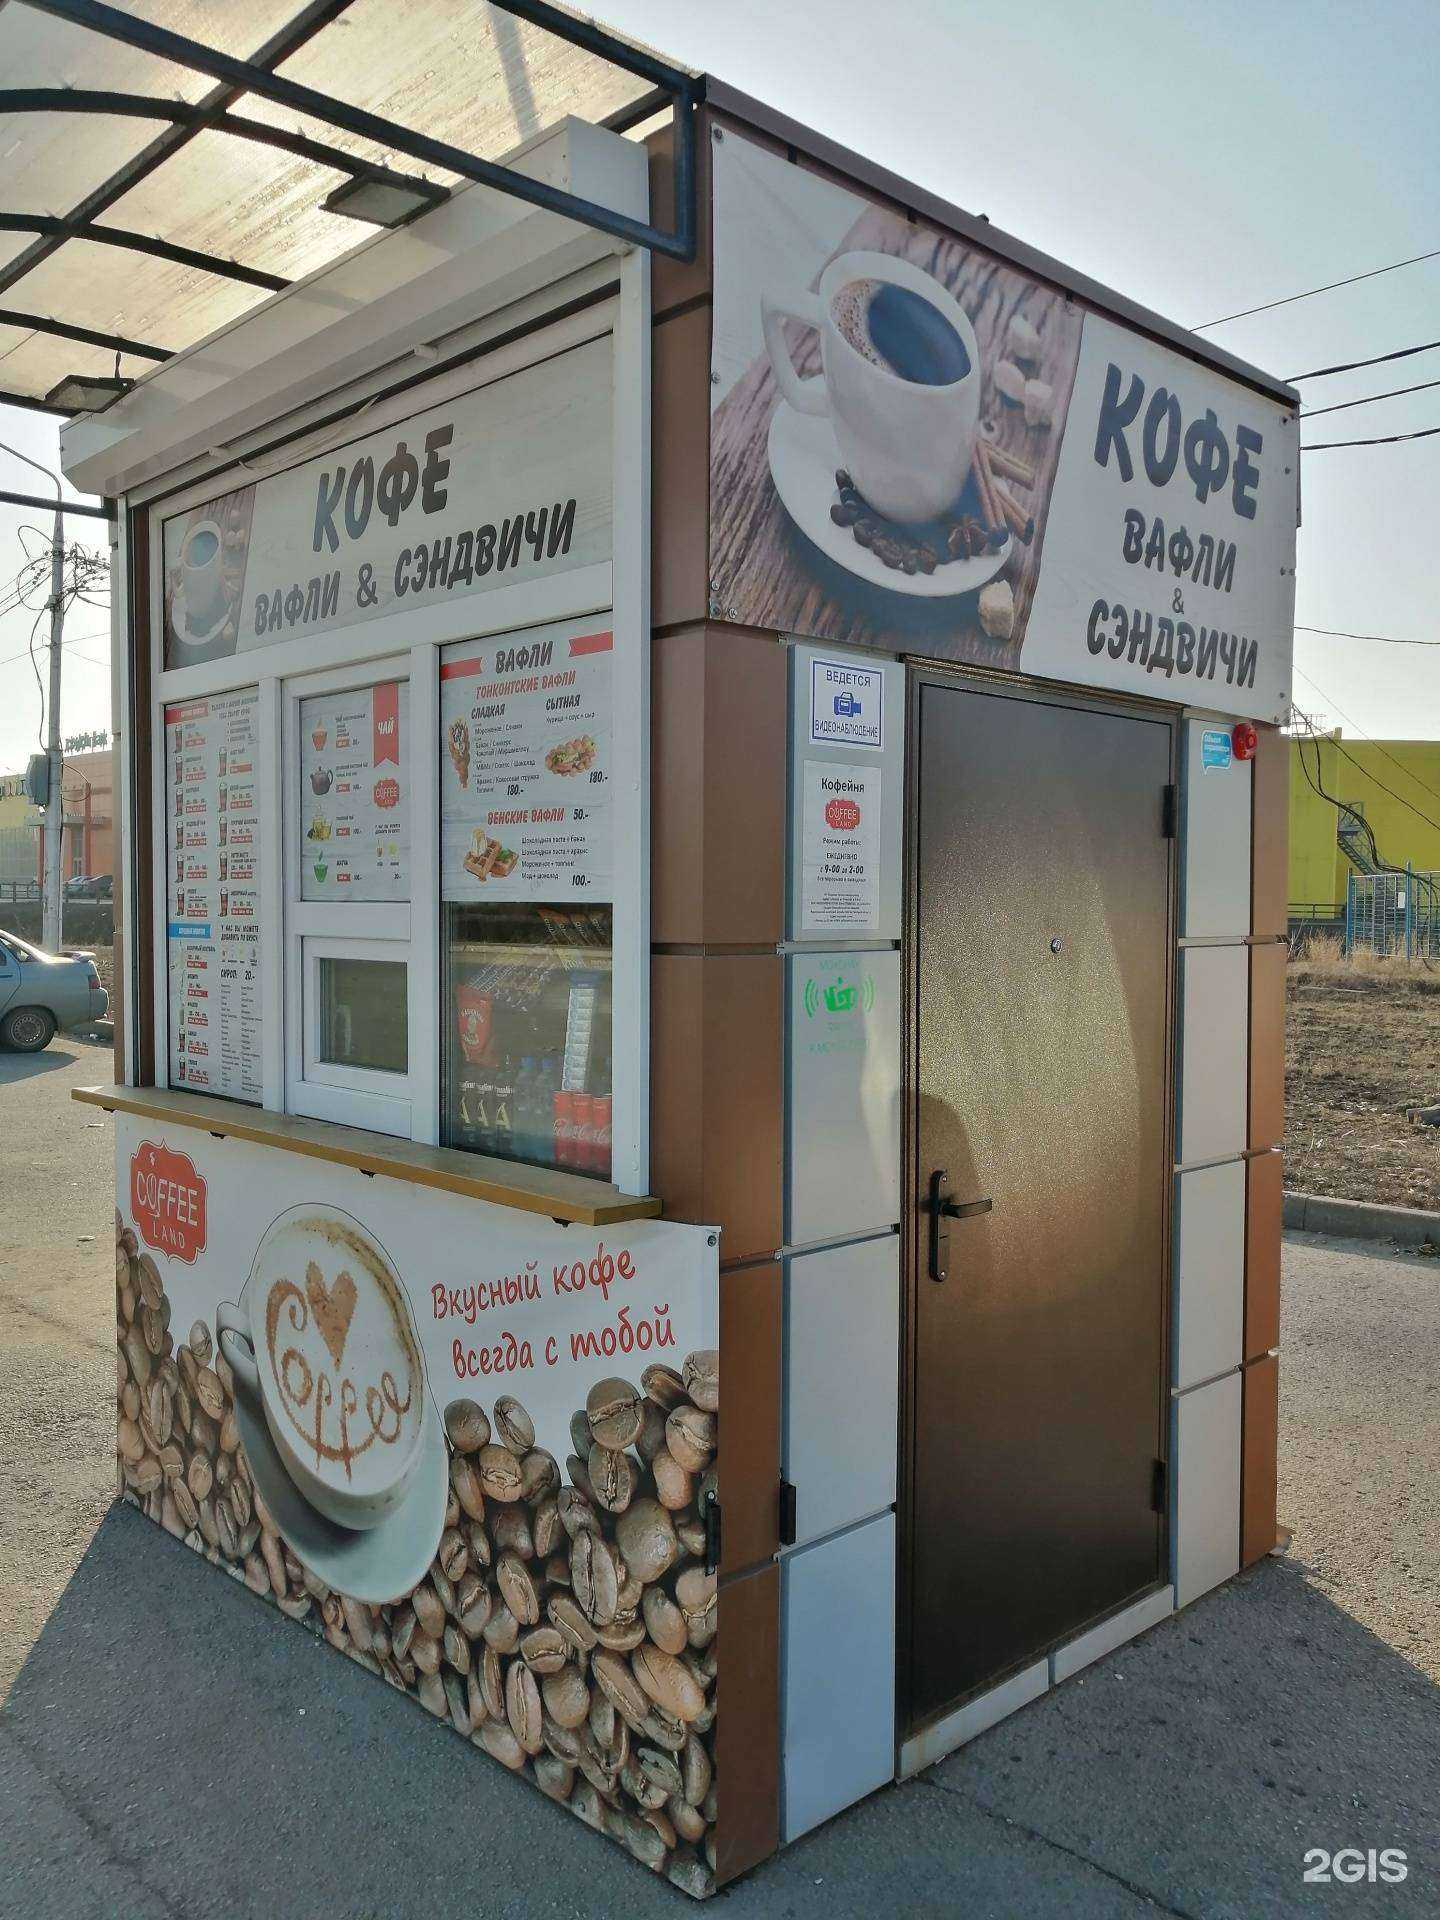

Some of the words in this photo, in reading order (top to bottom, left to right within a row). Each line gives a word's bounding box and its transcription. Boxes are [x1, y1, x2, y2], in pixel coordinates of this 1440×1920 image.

[1093, 362, 1264, 521] КОФЕ
[312, 423, 454, 554] КОФЕ
[1122, 508, 1237, 593] ВАФЛИ
[254, 569, 341, 635] ВАФЛИ
[356, 563, 378, 608] &
[394, 498, 577, 598] СЭНДВИЧИ
[1171, 587, 1185, 615] &
[495, 640, 554, 674] ВАФЛИ
[1086, 598, 1258, 689] СЭНДВИЧИ
[541, 669, 576, 689] ВАФЛИ
[826, 669, 871, 687] ВЕДЕТСЯ
[471, 703, 506, 719] СЛАДКАЯ
[545, 694, 581, 711] СЫТНАЯ
[377, 715, 394, 735] ЧАЙ
[815, 719, 878, 738] ВИДЕОНАБЛЮДЕНИЕ
[821, 777, 865, 794] Кофейня
[487, 809, 528, 825] ВЕНСКИЕ
[531, 807, 565, 823] ВАФЛИ
[136, 1171, 199, 1228] COFFEE
[153, 1227, 186, 1249] LAND
[431, 1261, 542, 1325] Вкусный
[553, 1241, 637, 1302] кофе
[452, 1331, 534, 1379] всегда
[545, 1336, 558, 1365] с
[570, 1302, 677, 1360] тобой
